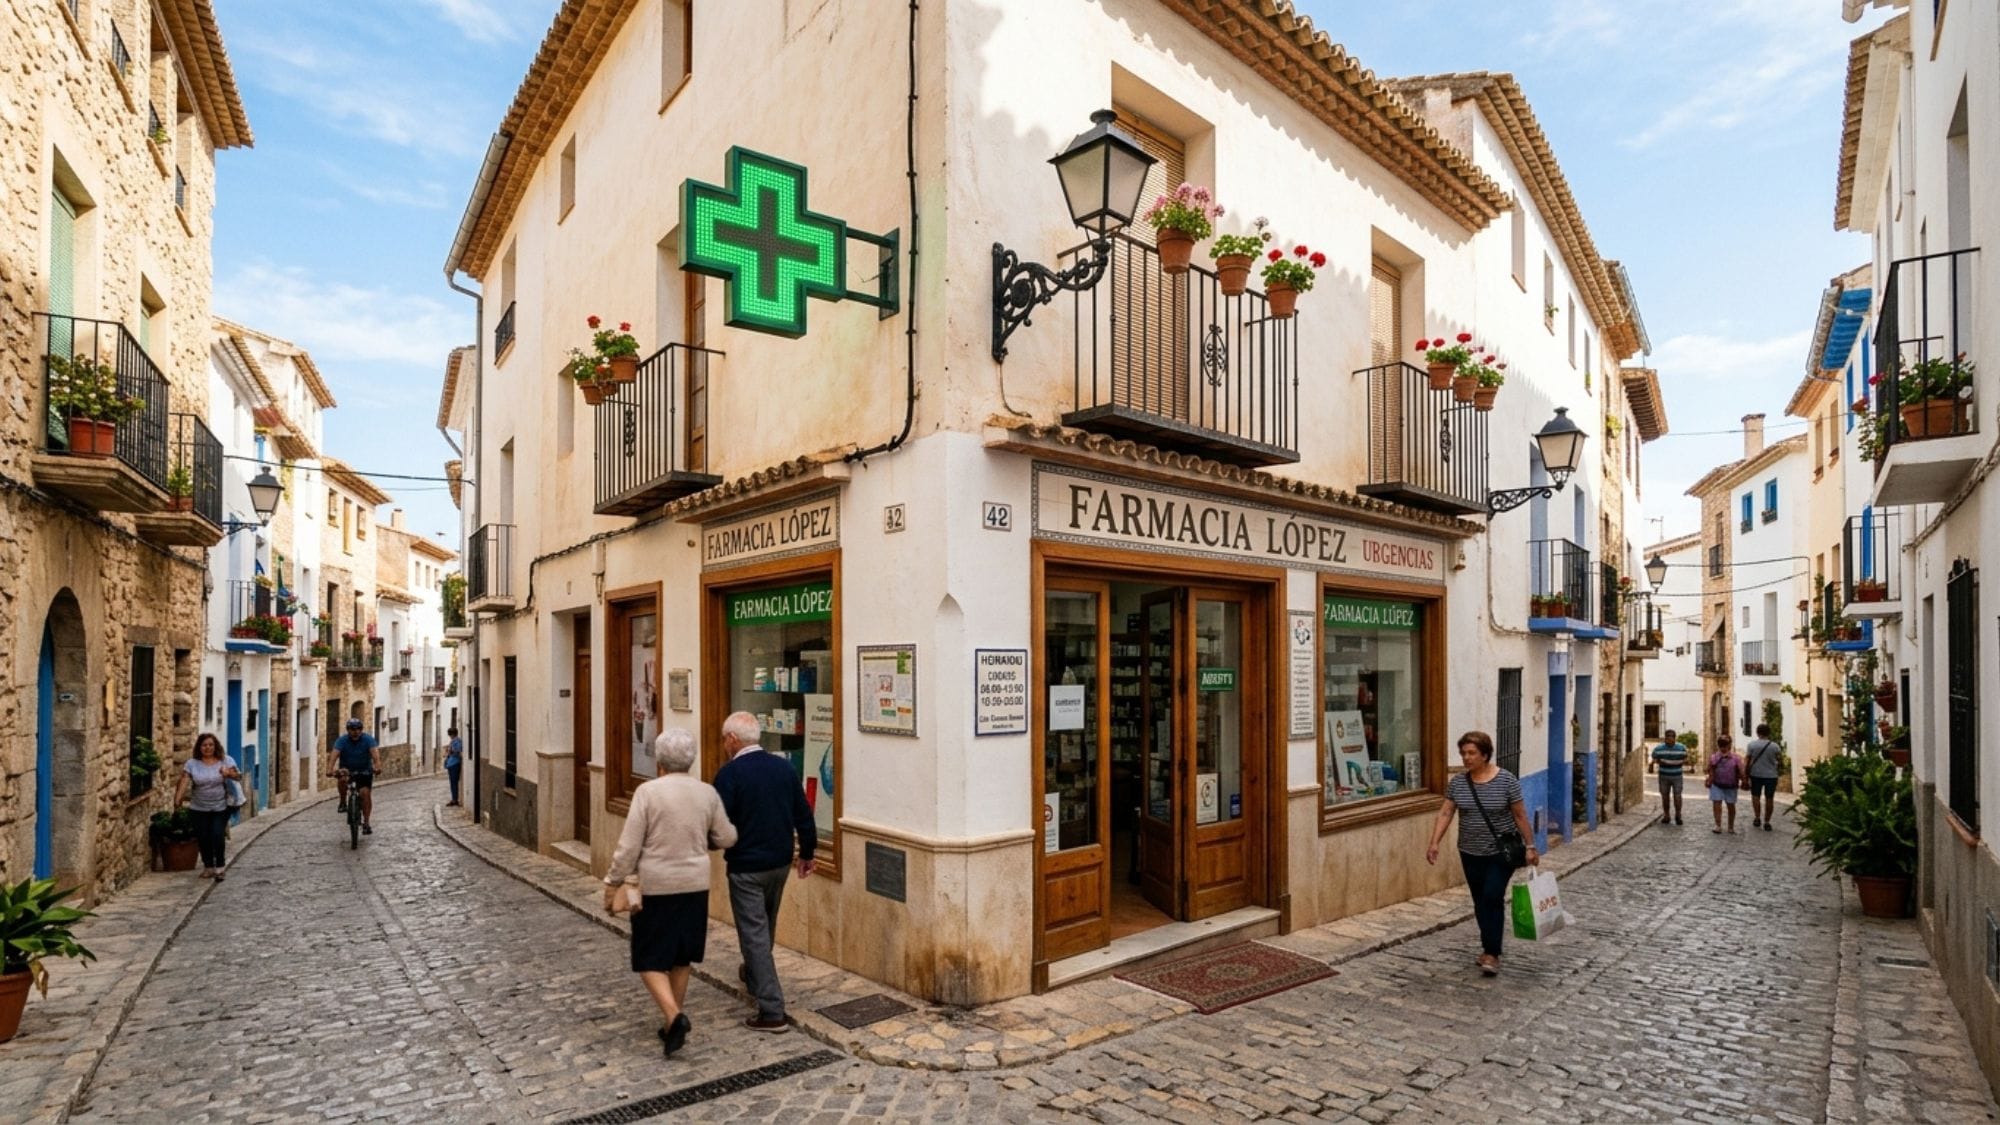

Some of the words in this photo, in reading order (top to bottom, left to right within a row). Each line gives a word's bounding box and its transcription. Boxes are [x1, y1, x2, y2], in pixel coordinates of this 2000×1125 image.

[707, 521, 776, 560] FARMACIA
[780, 506, 832, 545] LÓPEZ
[986, 505, 1009, 527] 42
[1068, 484, 1253, 551] FARMACIA
[1266, 511, 1347, 564] LÓPEZ
[1362, 539, 1434, 571] URGENCIAS
[793, 586, 833, 615] LÓPEZ
